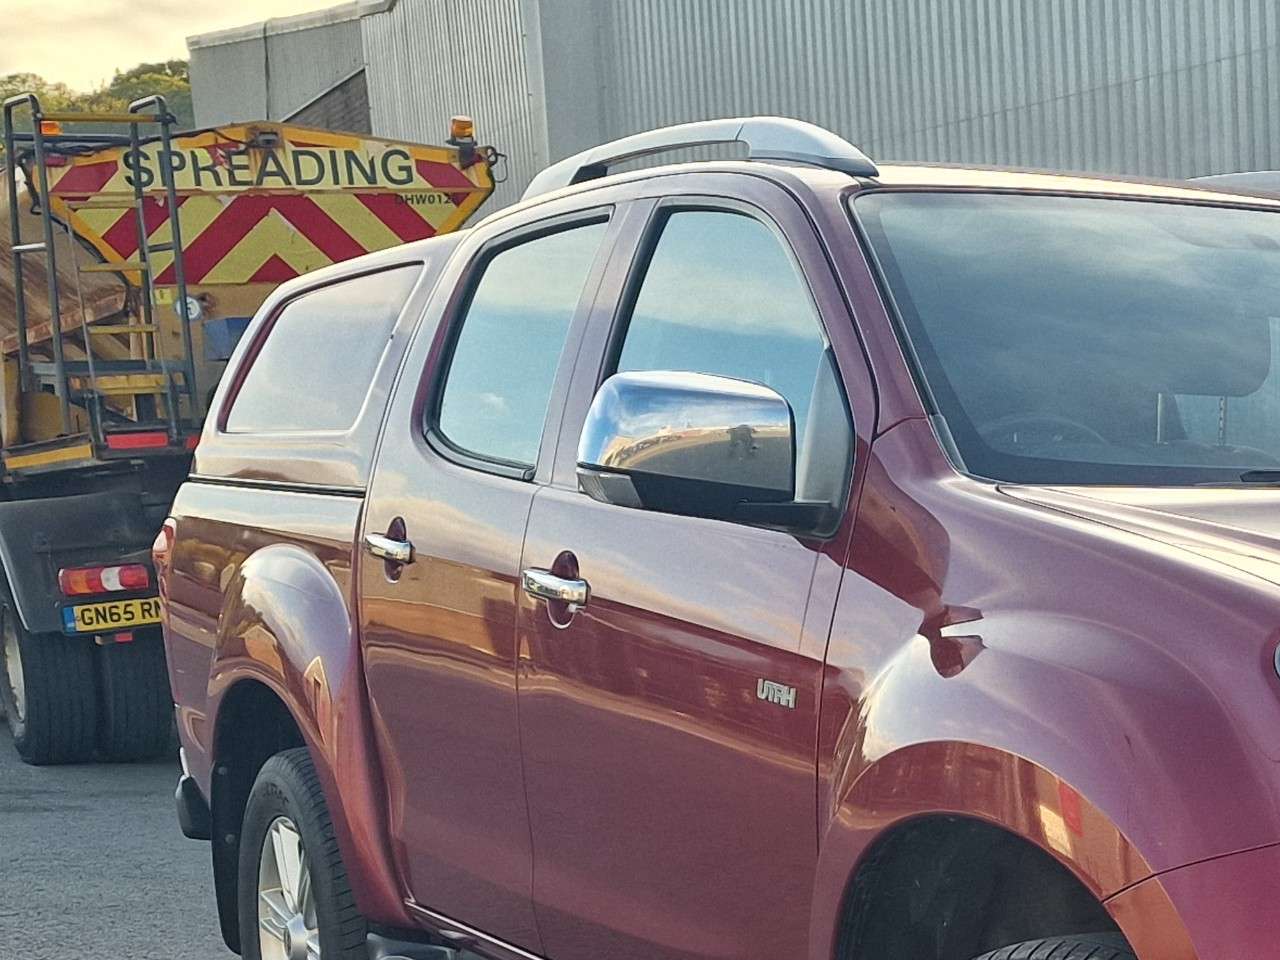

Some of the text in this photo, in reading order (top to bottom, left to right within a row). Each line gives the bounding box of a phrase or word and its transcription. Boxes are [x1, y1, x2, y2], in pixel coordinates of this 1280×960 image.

[123, 149, 414, 189] SPREADING
[80, 603, 135, 626] GN65
[756, 678, 797, 709] UTAH
